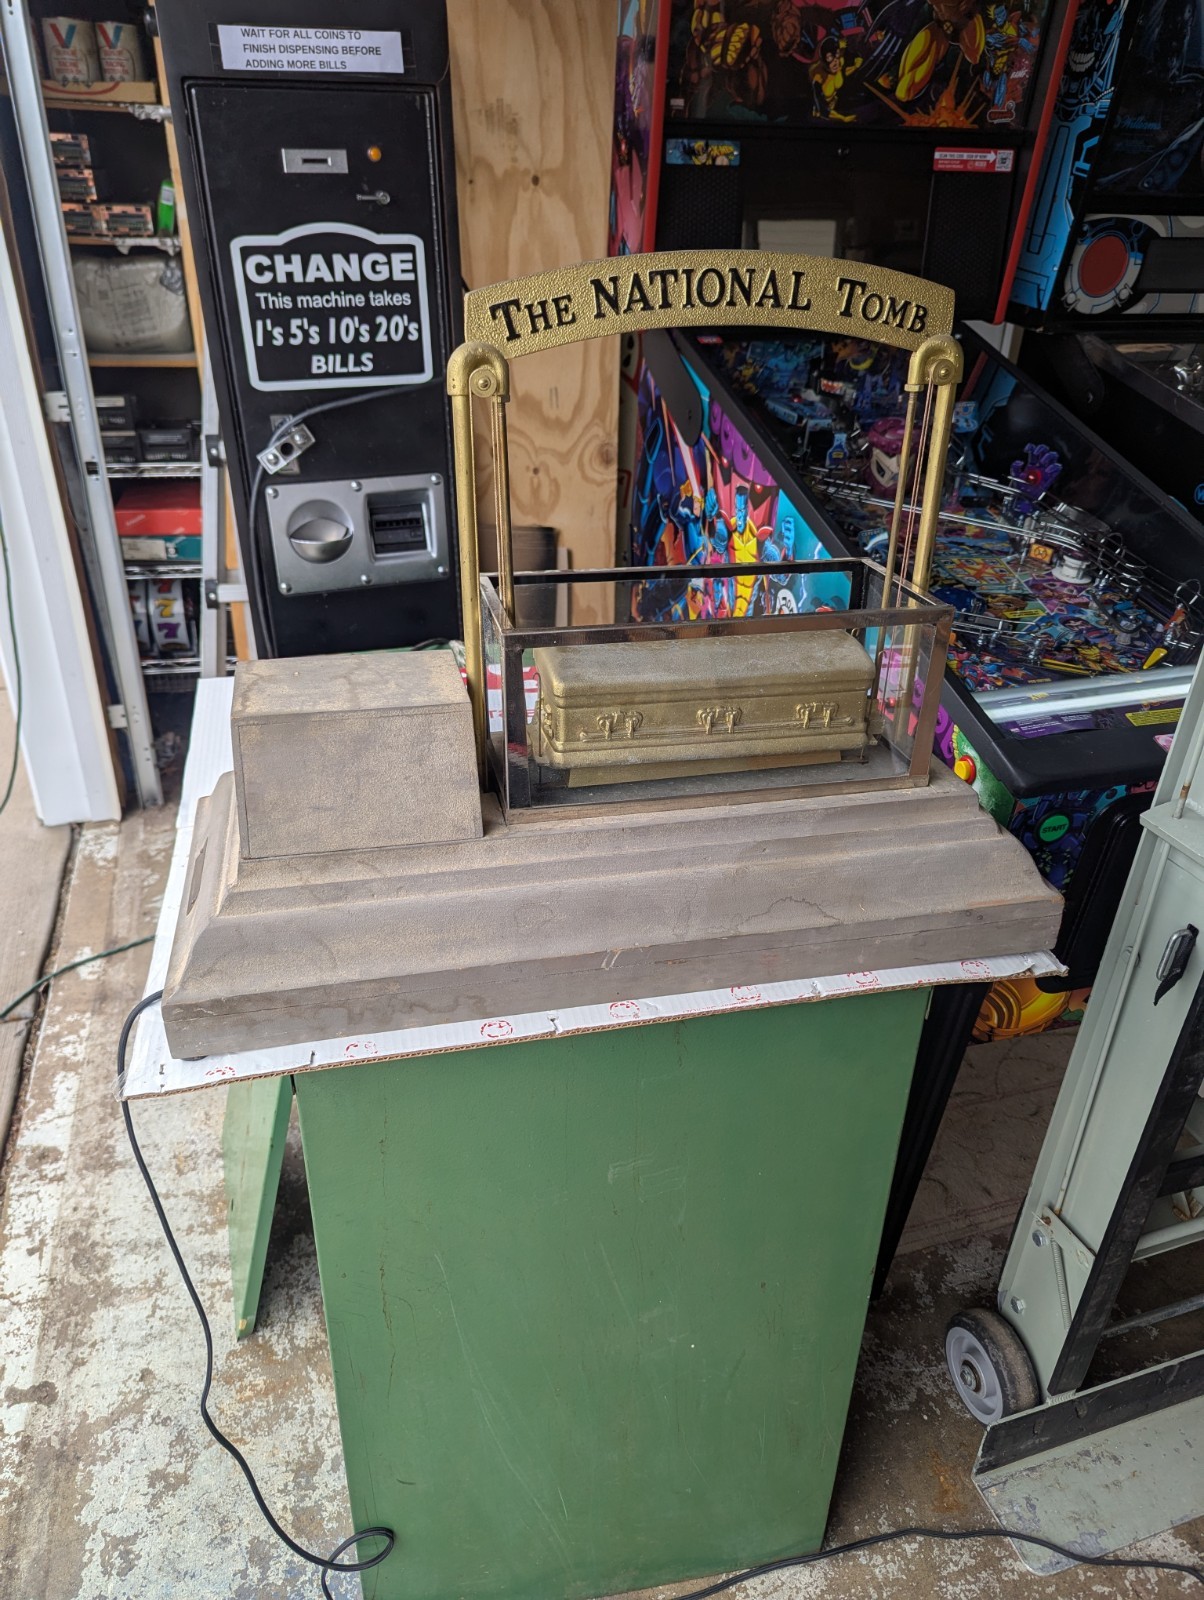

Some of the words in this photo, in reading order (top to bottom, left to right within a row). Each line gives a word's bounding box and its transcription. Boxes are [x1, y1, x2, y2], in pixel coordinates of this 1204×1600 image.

[240, 28, 266, 38] WAIT
[269, 29, 291, 39] FOR
[293, 29, 312, 40] ALL
[314, 30, 346, 40] COINS
[347, 31, 362, 41] TO
[243, 43, 277, 54] FINISH
[279, 44, 340, 56] DISPENSING
[342, 46, 382, 56] BEFORE
[245, 59, 285, 69] ADDING
[287, 60, 317, 70] MORE
[319, 60, 347, 70] BILLS
[245, 252, 416, 284] CHANGE
[255, 291, 293, 310] This
[297, 290, 365, 309] machine
[368, 289, 412, 307] takes
[488, 293, 577, 342] THE
[590, 267, 812, 320] NATIONAL
[836, 276, 929, 335] TOMB
[256, 318, 284, 347] 1's
[289, 317, 321, 346] 5's
[329, 315, 371, 344] 10's
[375, 314, 419, 343] 20's
[311, 352, 374, 374] BILLS
[1042, 822, 1068, 834] START
